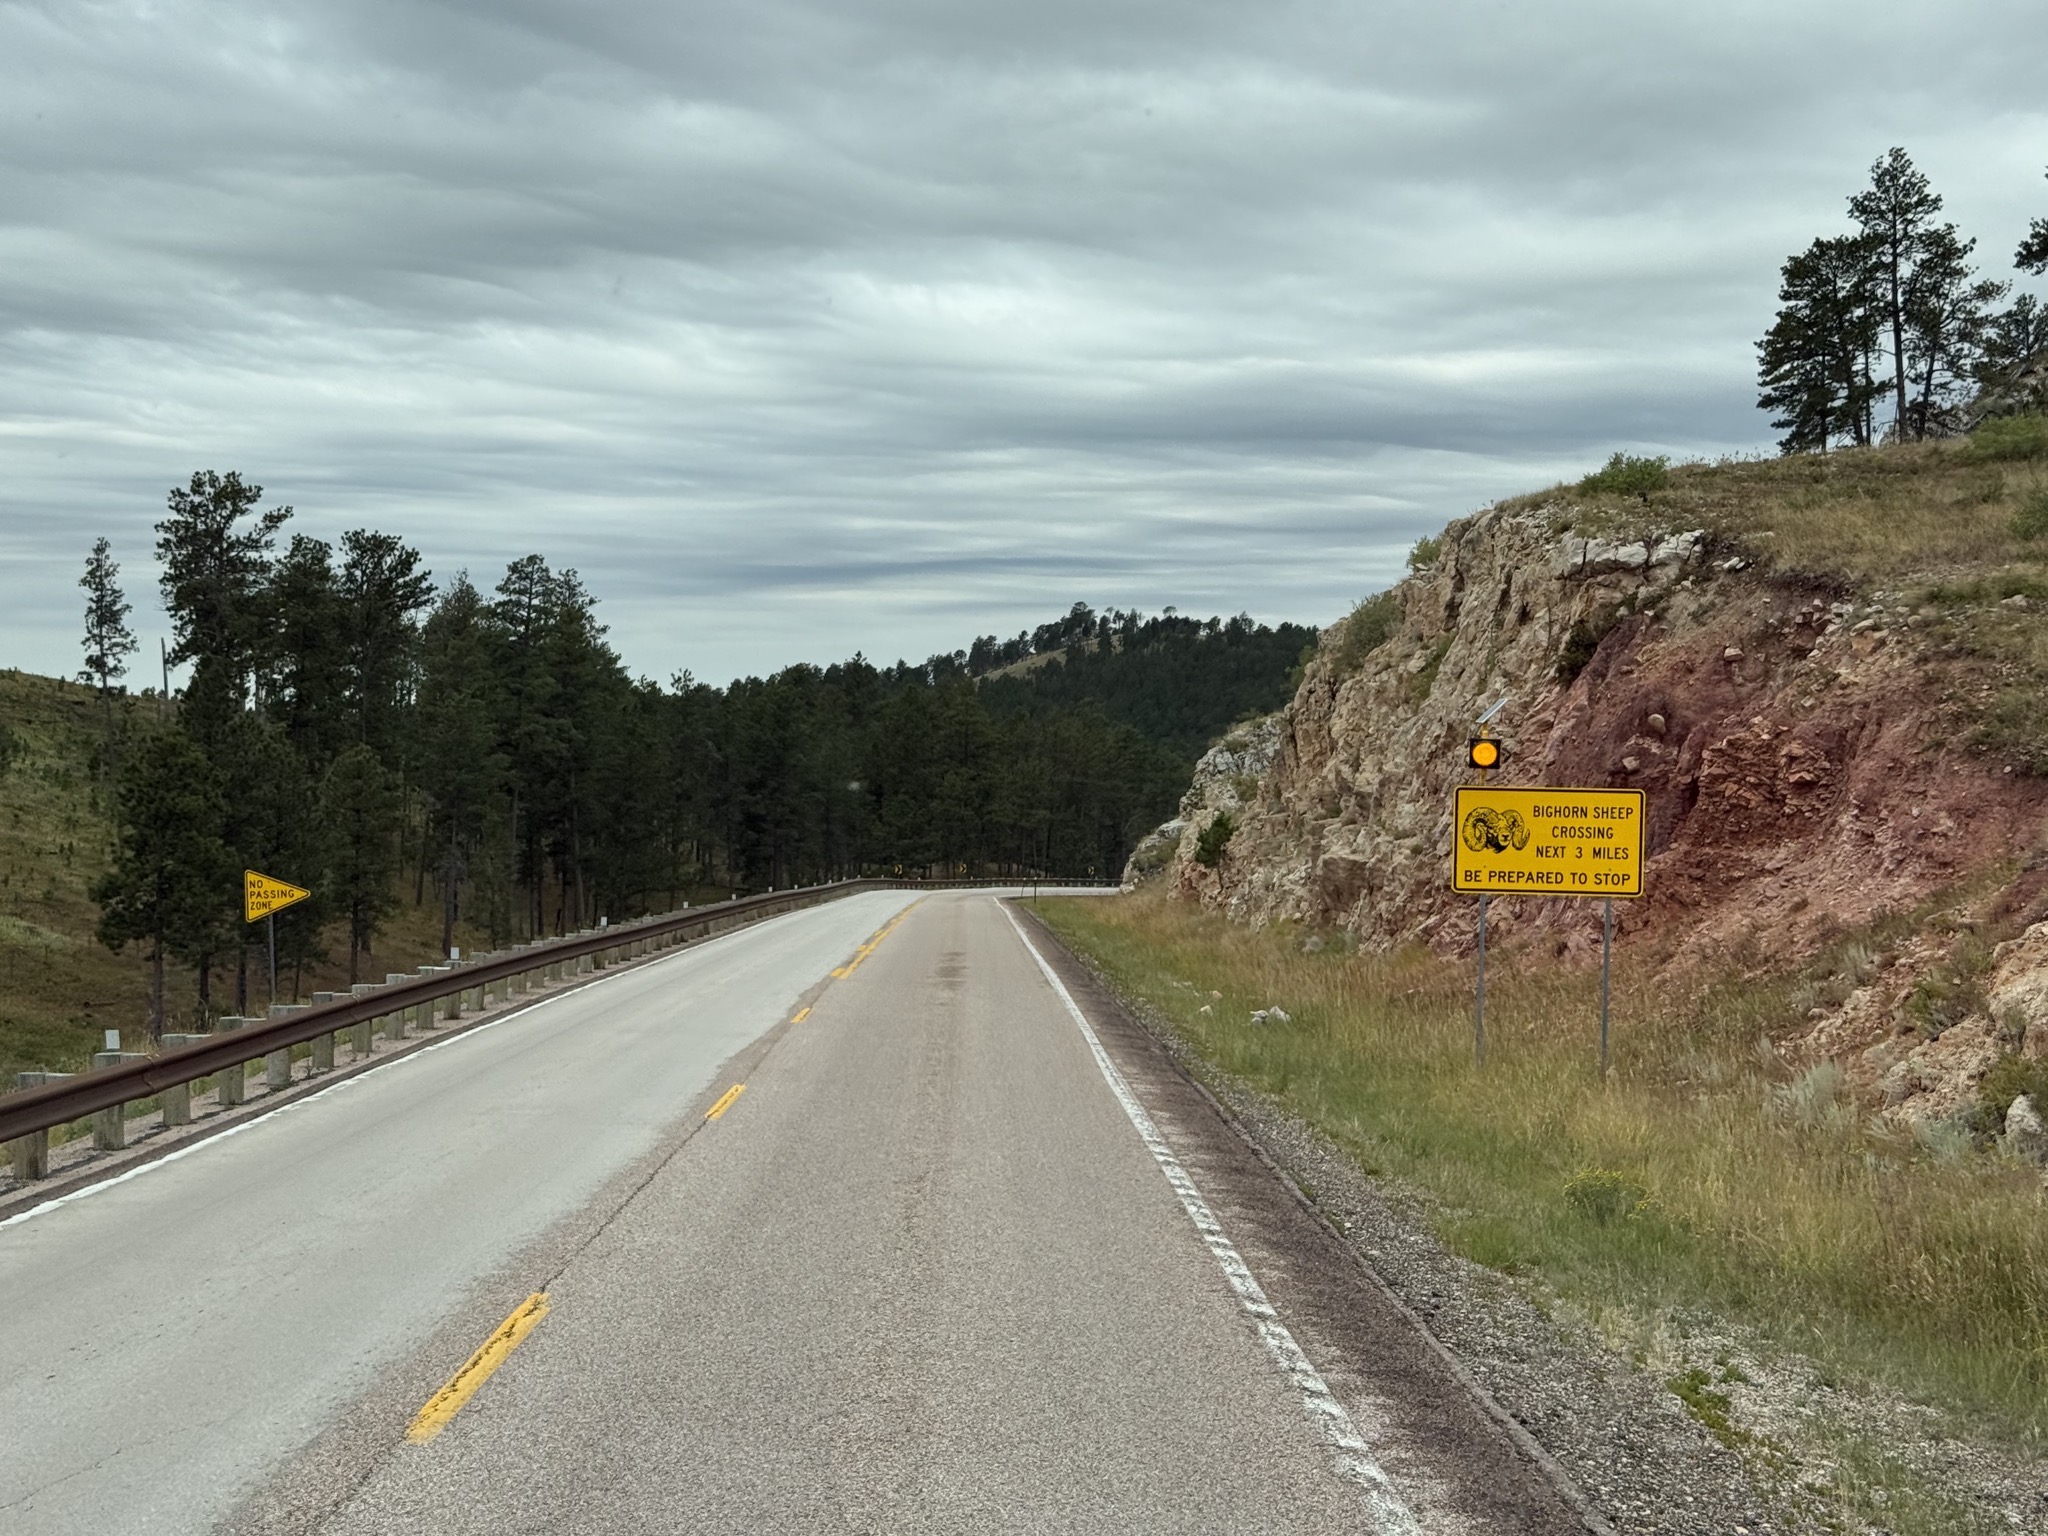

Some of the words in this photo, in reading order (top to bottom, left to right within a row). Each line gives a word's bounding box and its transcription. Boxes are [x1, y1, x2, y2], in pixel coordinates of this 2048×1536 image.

[1532, 805, 1588, 819] BIGHORN
[1592, 806, 1634, 820] SHEEP
[1551, 826, 1614, 839] CROSSING
[1535, 846, 1566, 859] NEXT
[1575, 847, 1583, 859] 3
[1592, 847, 1629, 860] MILES
[249, 880, 264, 889] NO
[1464, 870, 1482, 883] BE
[1488, 870, 1564, 885] PREPARED
[1570, 872, 1588, 885] TO
[1593, 873, 1631, 886] STOP
[249, 889, 295, 899] PASSING
[250, 901, 272, 910] ZONE
